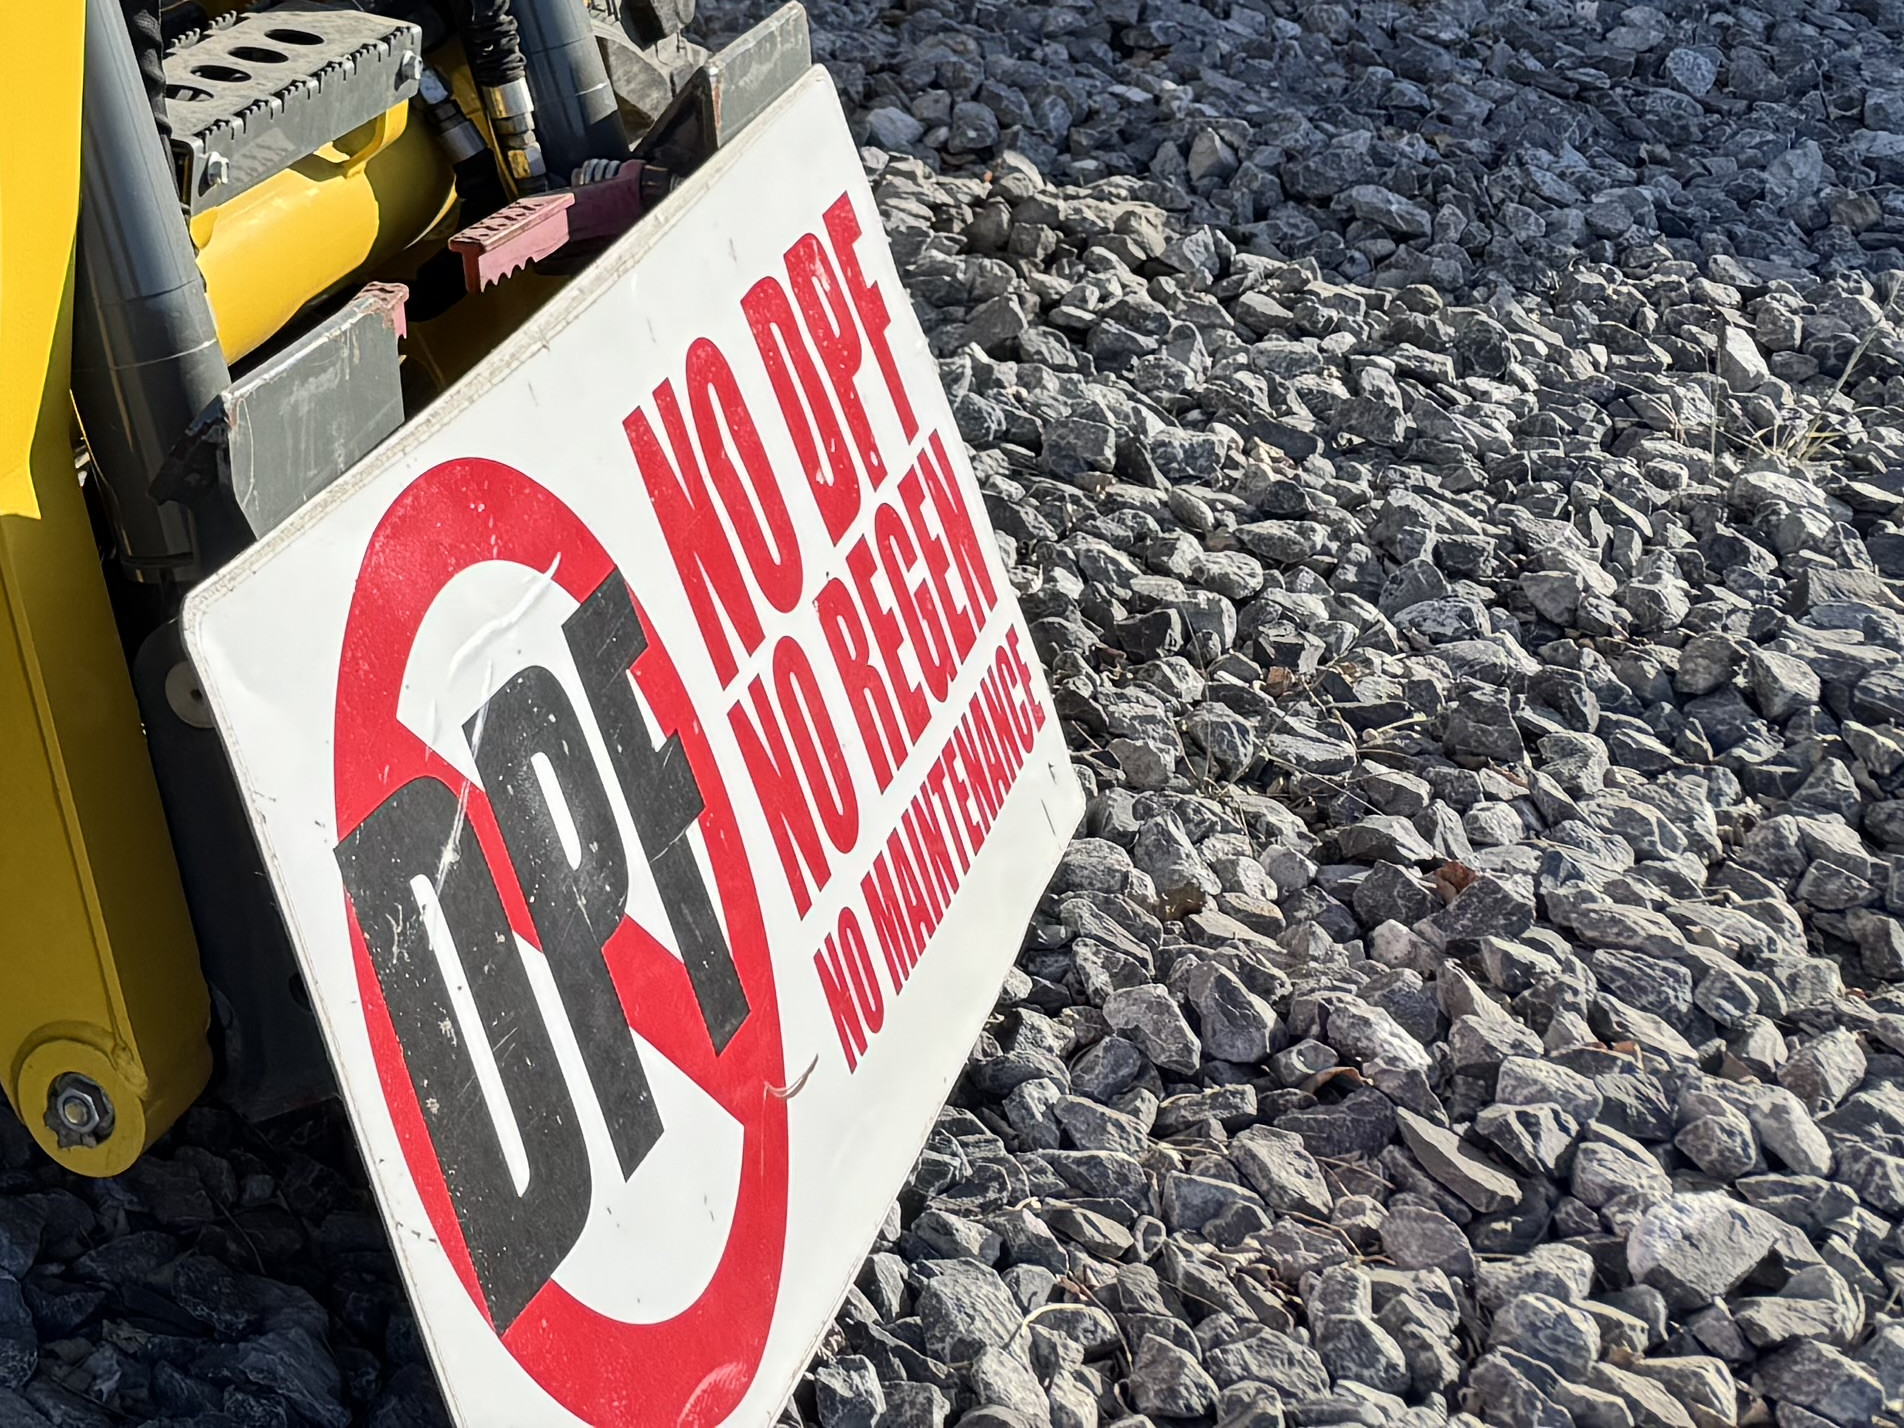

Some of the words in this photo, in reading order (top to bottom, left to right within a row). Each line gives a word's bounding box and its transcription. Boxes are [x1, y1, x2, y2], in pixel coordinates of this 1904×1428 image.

[622, 337, 804, 691] NO
[741, 190, 919, 548] DPF
[727, 635, 859, 921] NO
[812, 428, 998, 795] REGEN
[333, 564, 751, 1338] DPF
[813, 905, 885, 1075] NO
[860, 624, 1046, 997] MAINTENANCE
